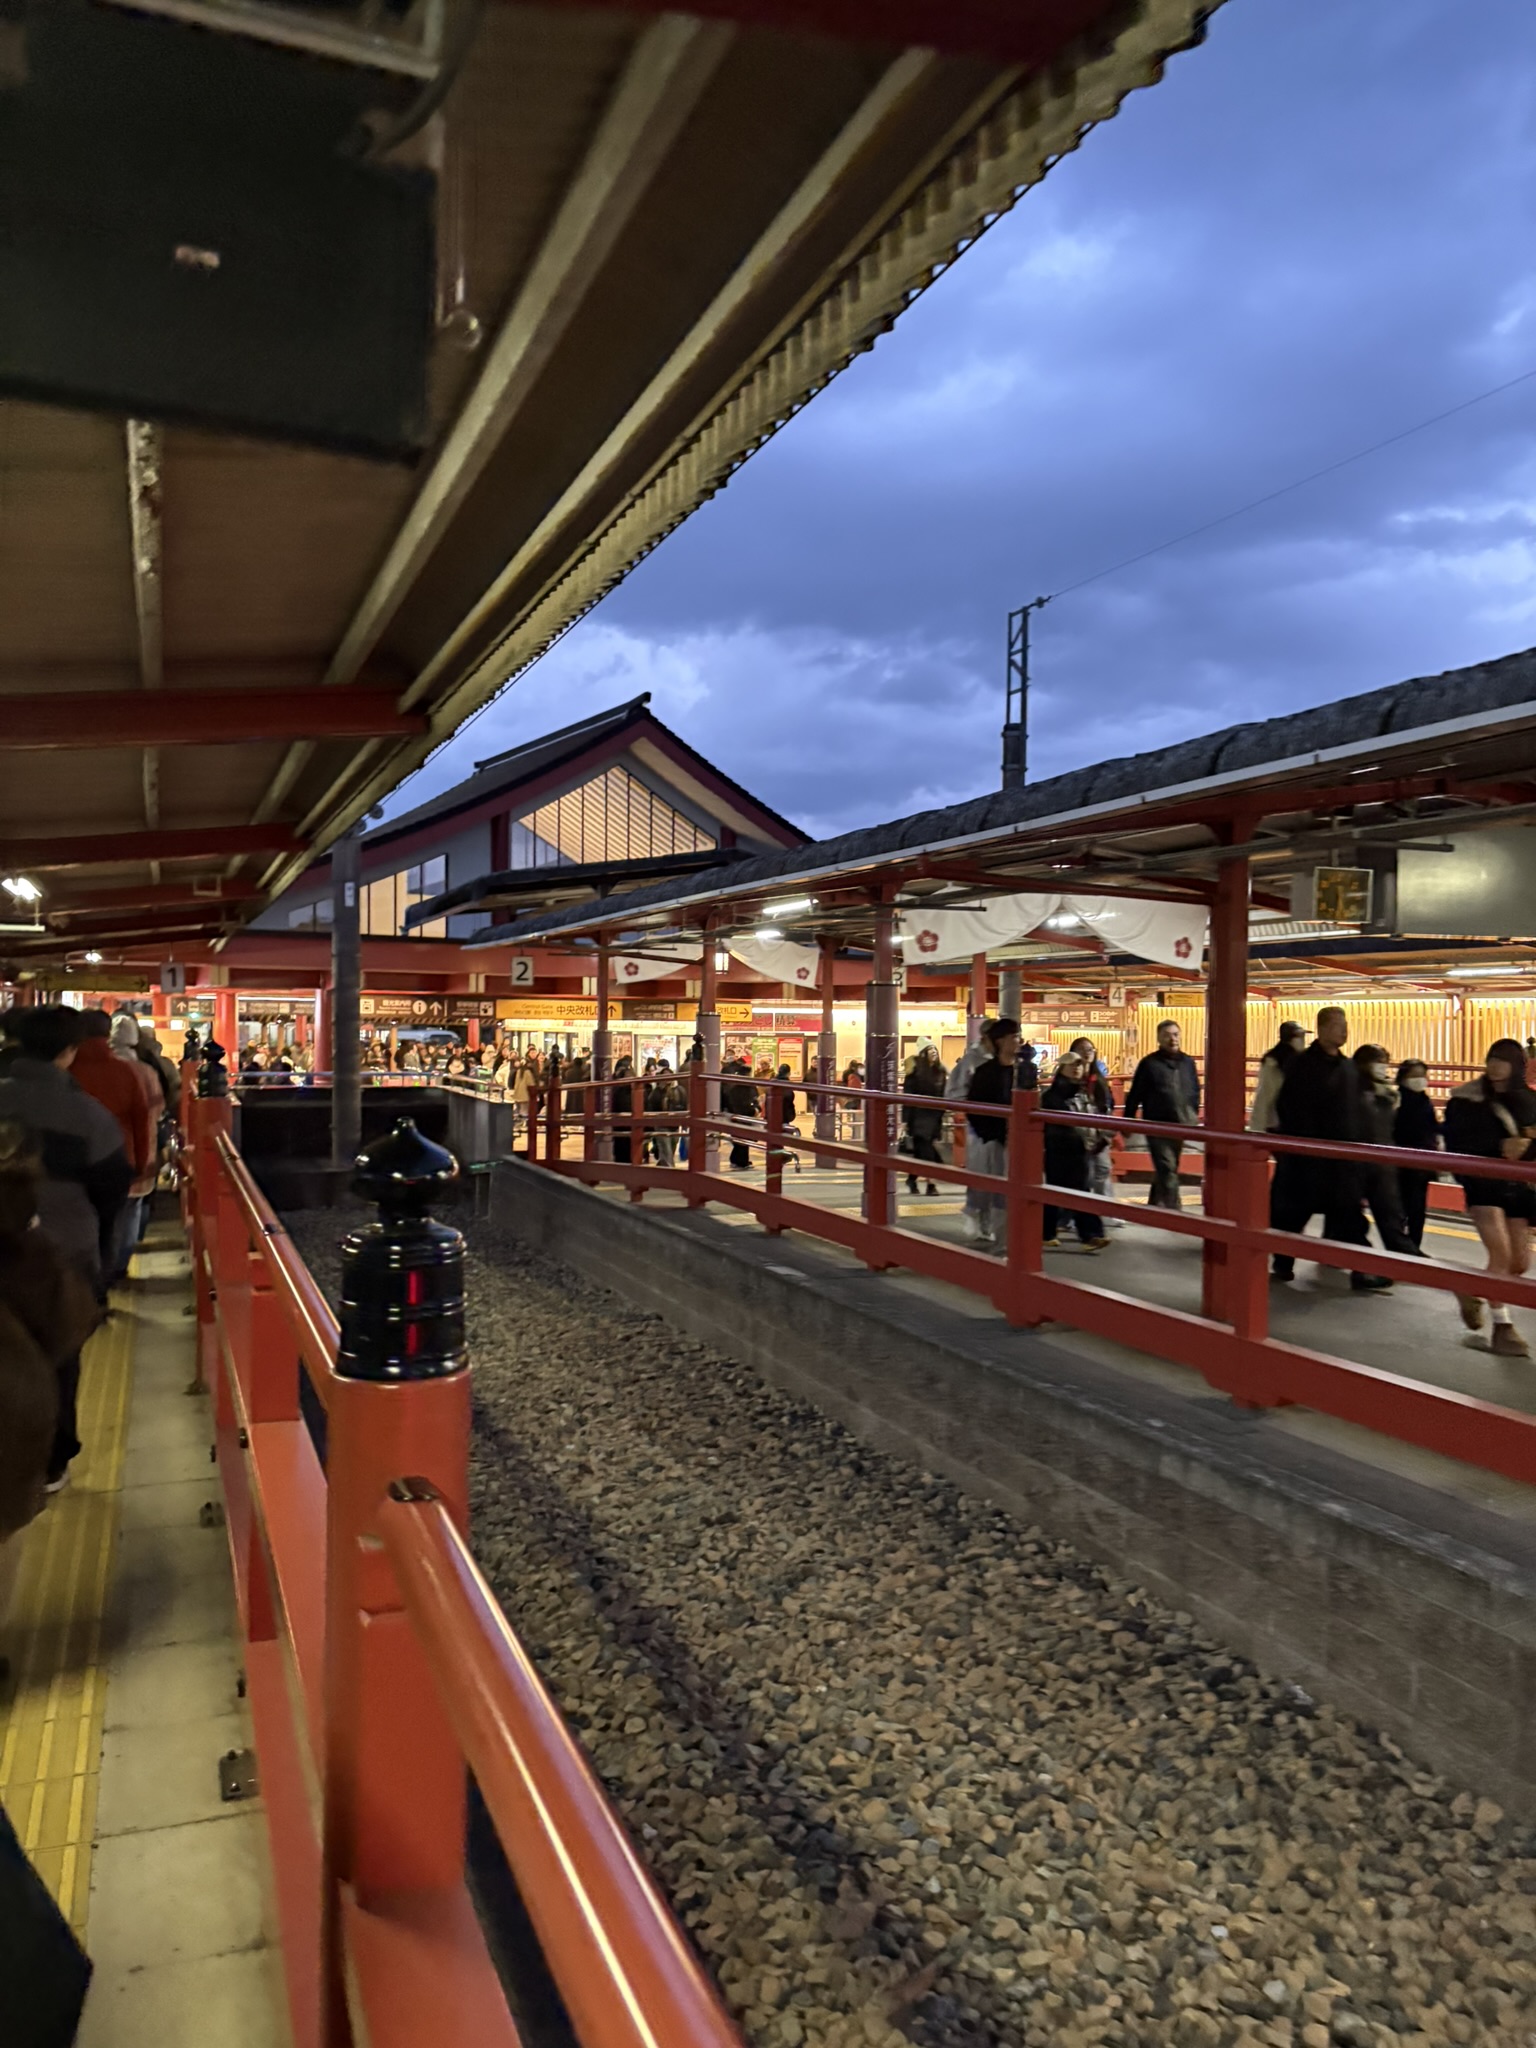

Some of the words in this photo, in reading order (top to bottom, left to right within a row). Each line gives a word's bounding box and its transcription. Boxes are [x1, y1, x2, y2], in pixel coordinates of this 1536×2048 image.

[167, 967, 177, 988] 1
[516, 961, 529, 981] 2
[1112, 986, 1123, 1003] 4
